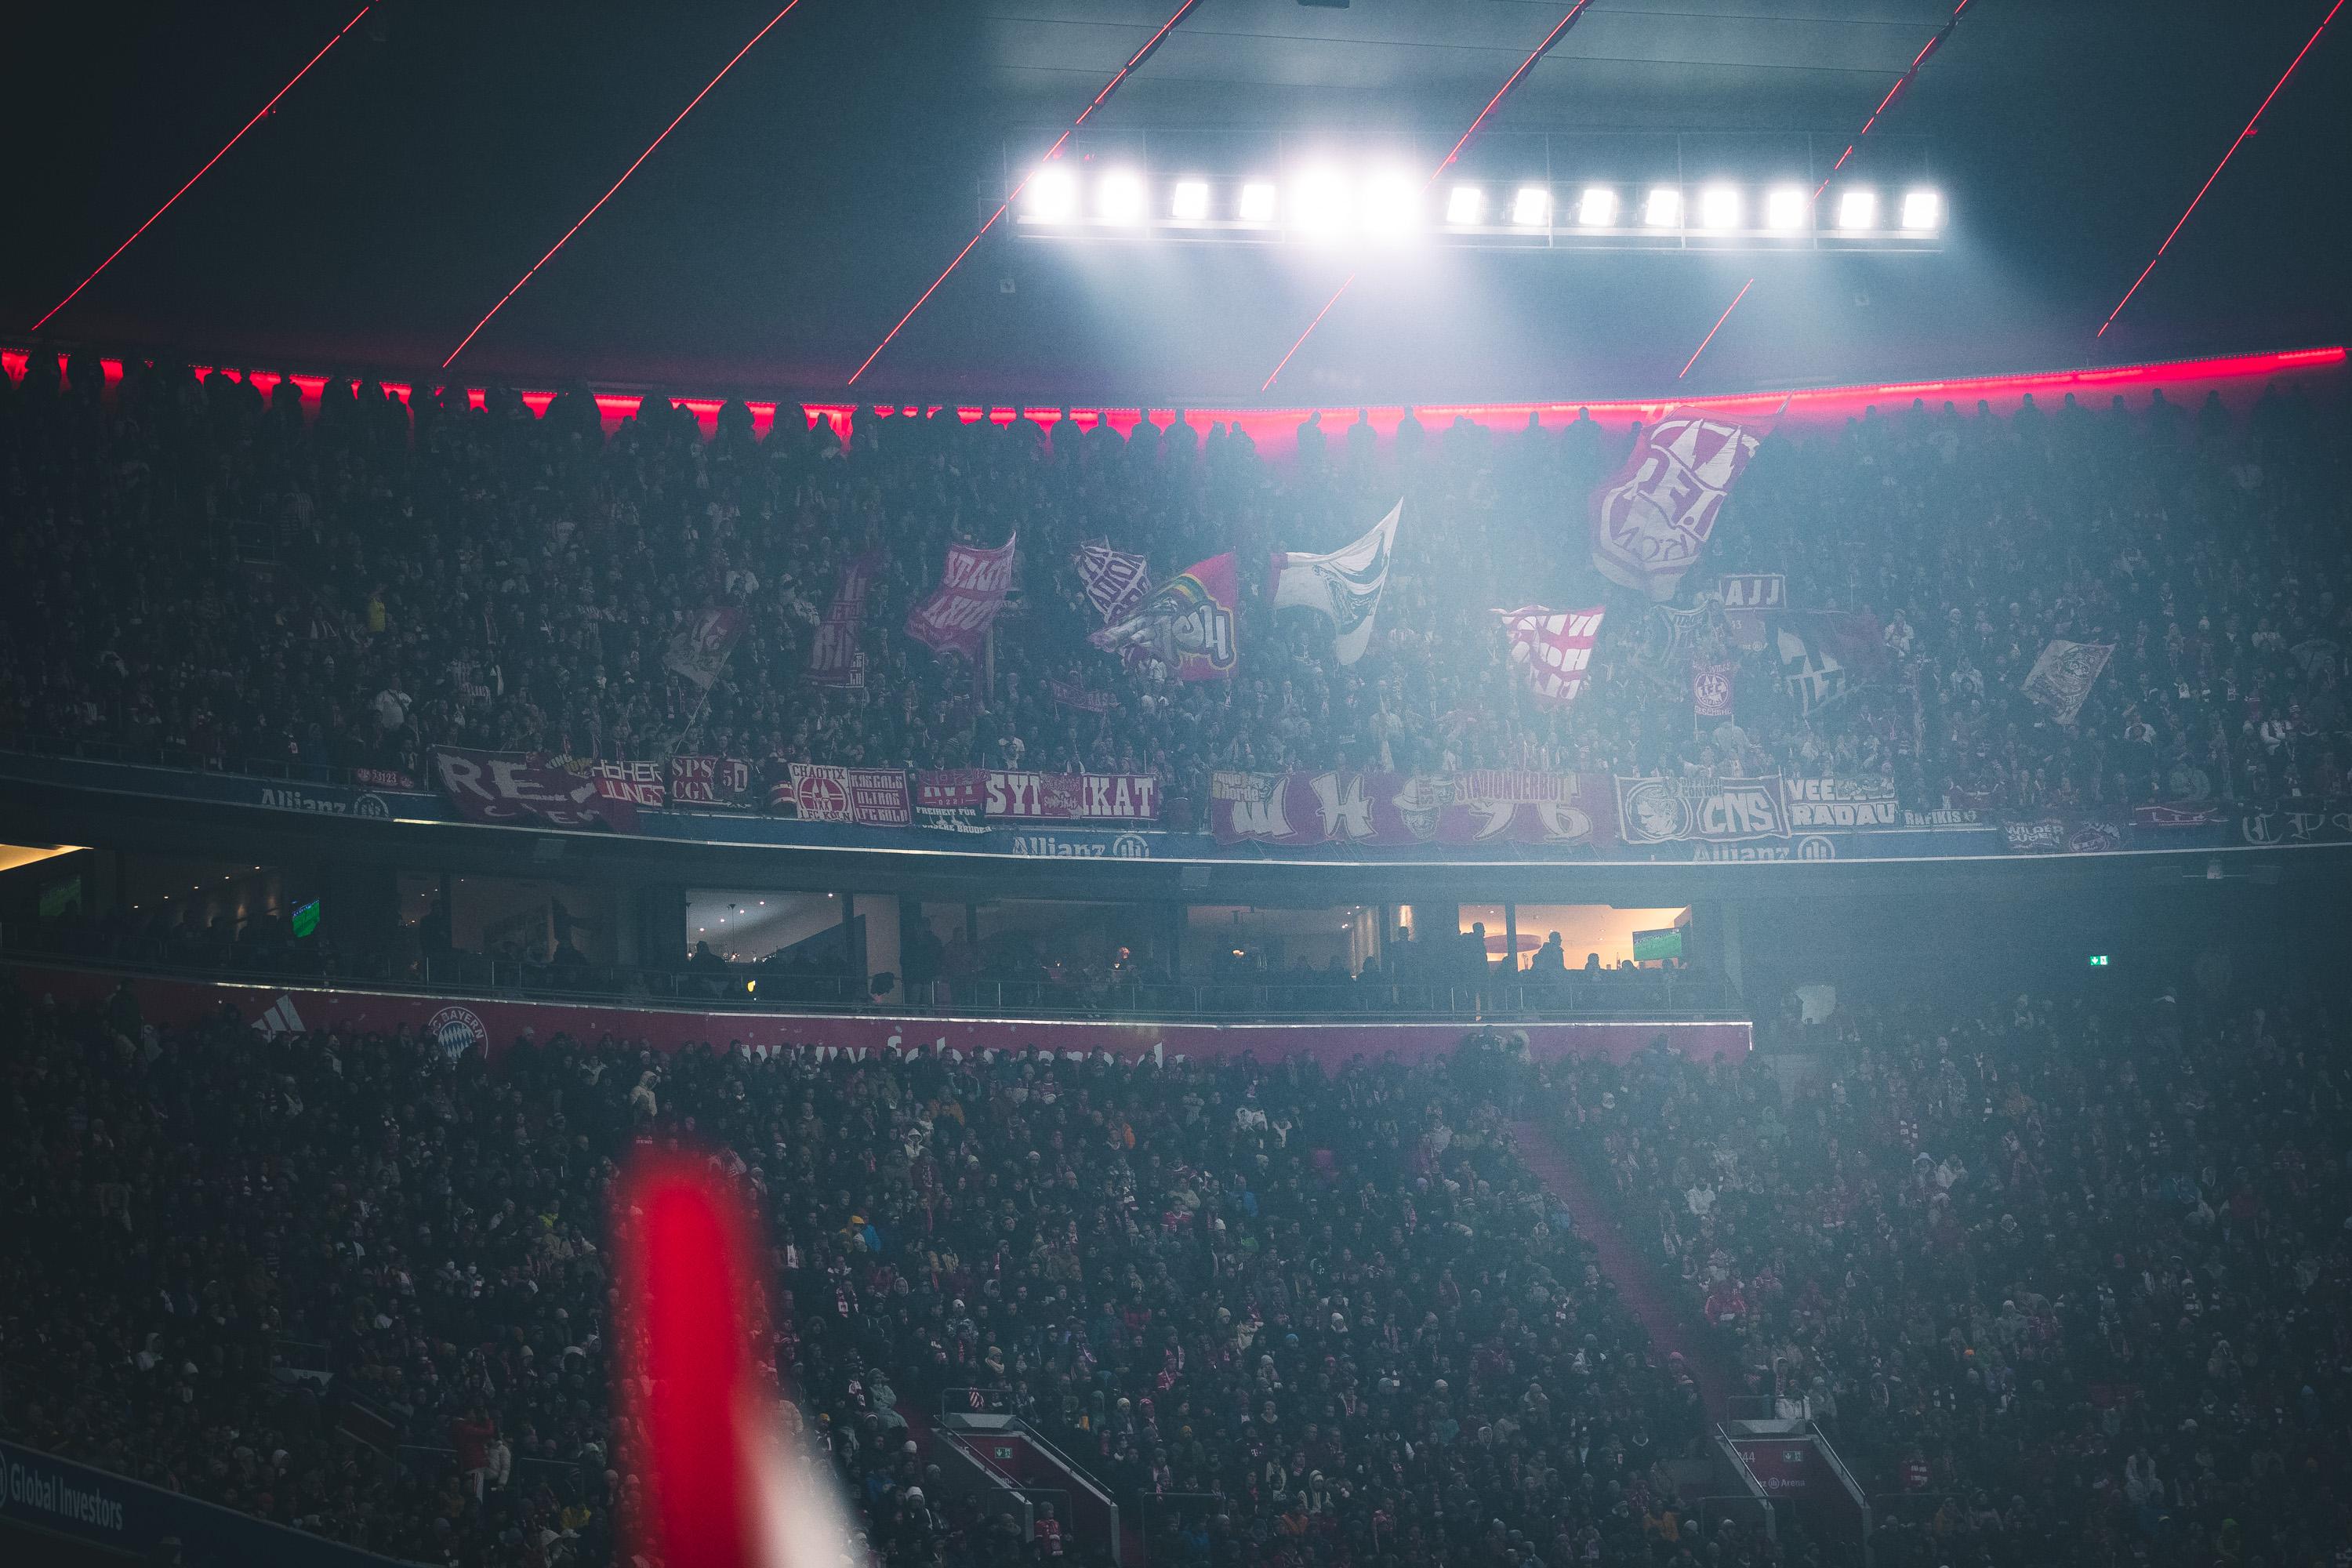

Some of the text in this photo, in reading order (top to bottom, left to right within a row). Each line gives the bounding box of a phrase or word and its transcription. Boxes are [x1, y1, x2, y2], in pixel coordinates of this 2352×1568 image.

[672, 759, 712, 778] SPS
[792, 765, 845, 780] CHAOTIX
[672, 781, 713, 800] CGN
[856, 791, 900, 805] ULTRAS
[261, 787, 347, 814] Allianz
[915, 806, 976, 816] FREIHEIT FÜR
[1703, 792, 1774, 833] CNS
[1791, 803, 1896, 826] RADAU
[1011, 837, 1105, 857] Allianz
[1692, 844, 1789, 862] Allianz
[440, 1010, 485, 1039] BAYERN
[1780, 1479, 1806, 1487] Arena
[10, 1463, 123, 1530] Global Investors
